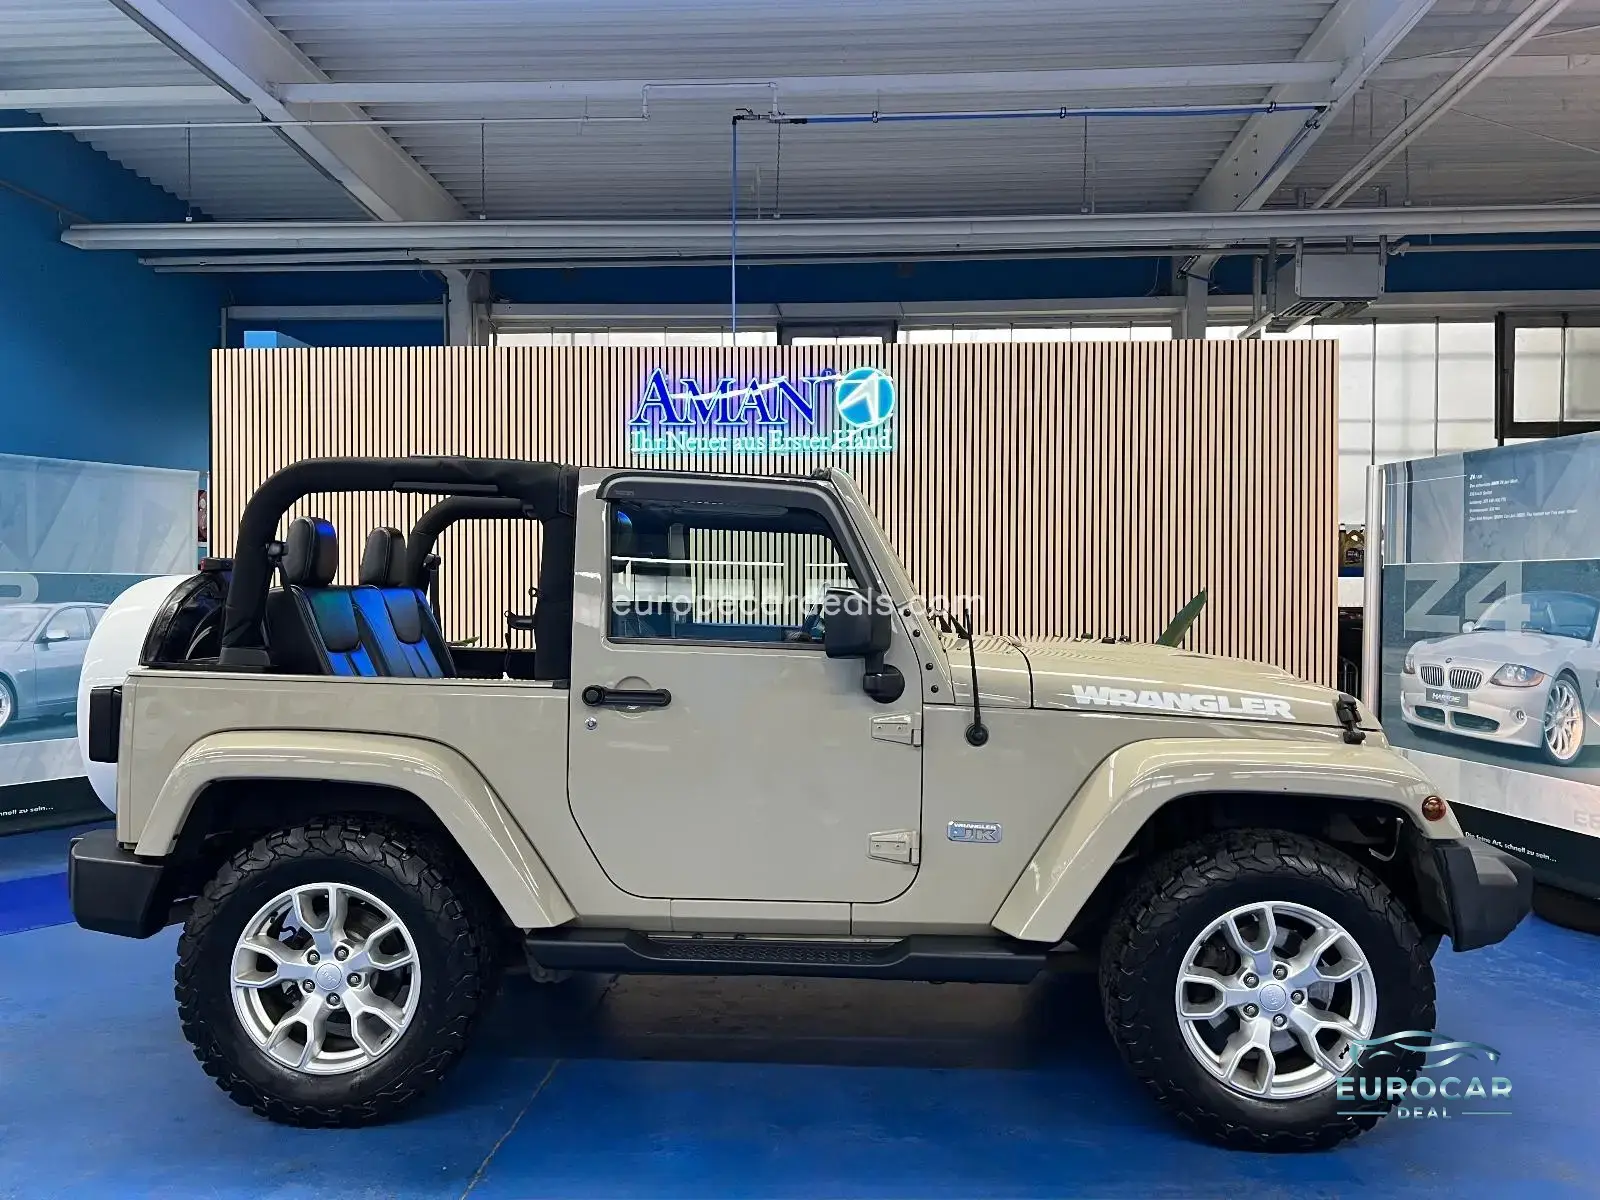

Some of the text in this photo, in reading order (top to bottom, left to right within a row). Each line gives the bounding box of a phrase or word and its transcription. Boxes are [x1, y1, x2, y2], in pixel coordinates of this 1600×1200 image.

[627, 367, 820, 426] AMAN
[630, 429, 893, 452] Ihr Neuer aus Erster Hand
[1404, 562, 1531, 633] Z4
[1072, 685, 1296, 719] WRANGLER
